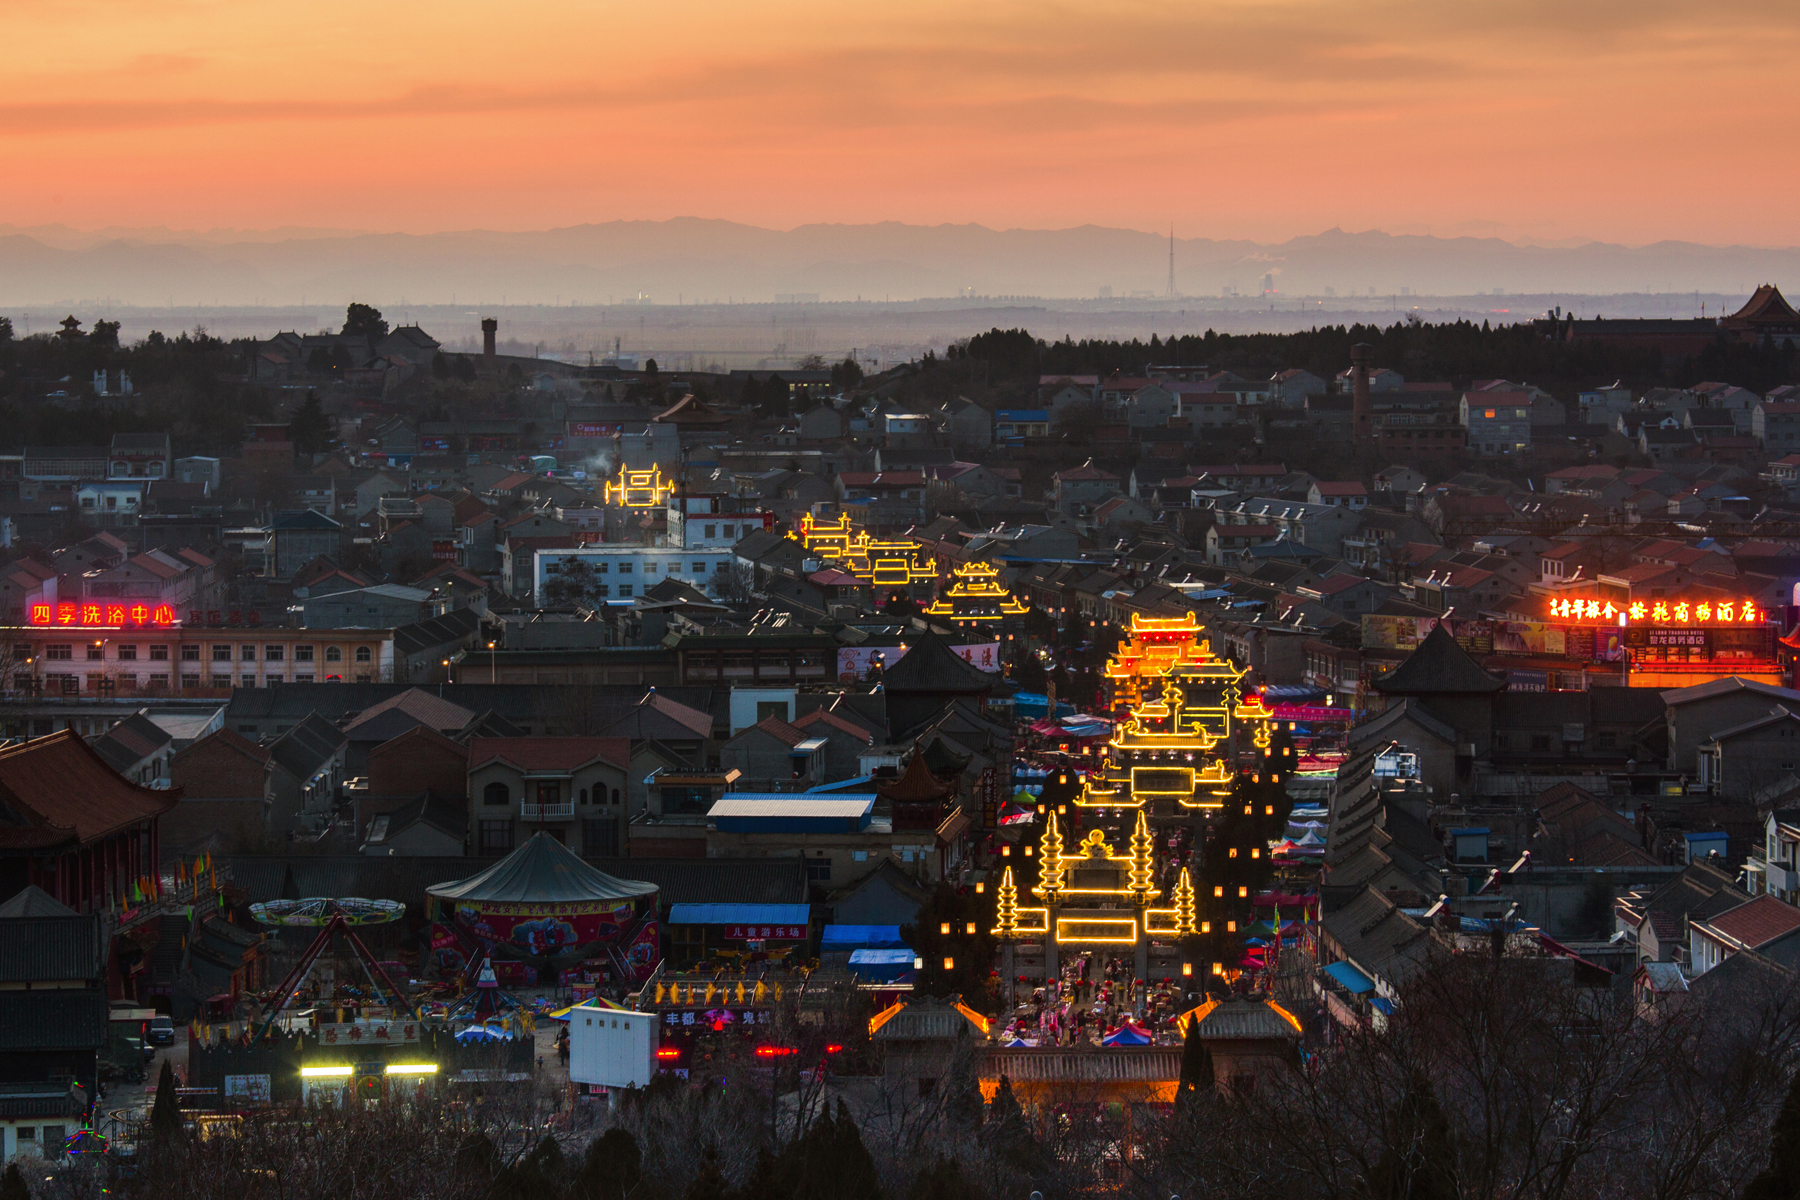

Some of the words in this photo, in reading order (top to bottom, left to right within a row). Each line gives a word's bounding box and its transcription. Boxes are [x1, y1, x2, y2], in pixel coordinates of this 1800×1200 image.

[33, 604, 173, 624] 四季洗浴中心
[1649, 635, 1705, 645] 黎龙商务酒店
[733, 927, 800, 938] 儿童游乐场
[666, 1011, 695, 1026] 丰都
[742, 1011, 771, 1025] 鬼城
[325, 1024, 416, 1043] 恐怖城堡
